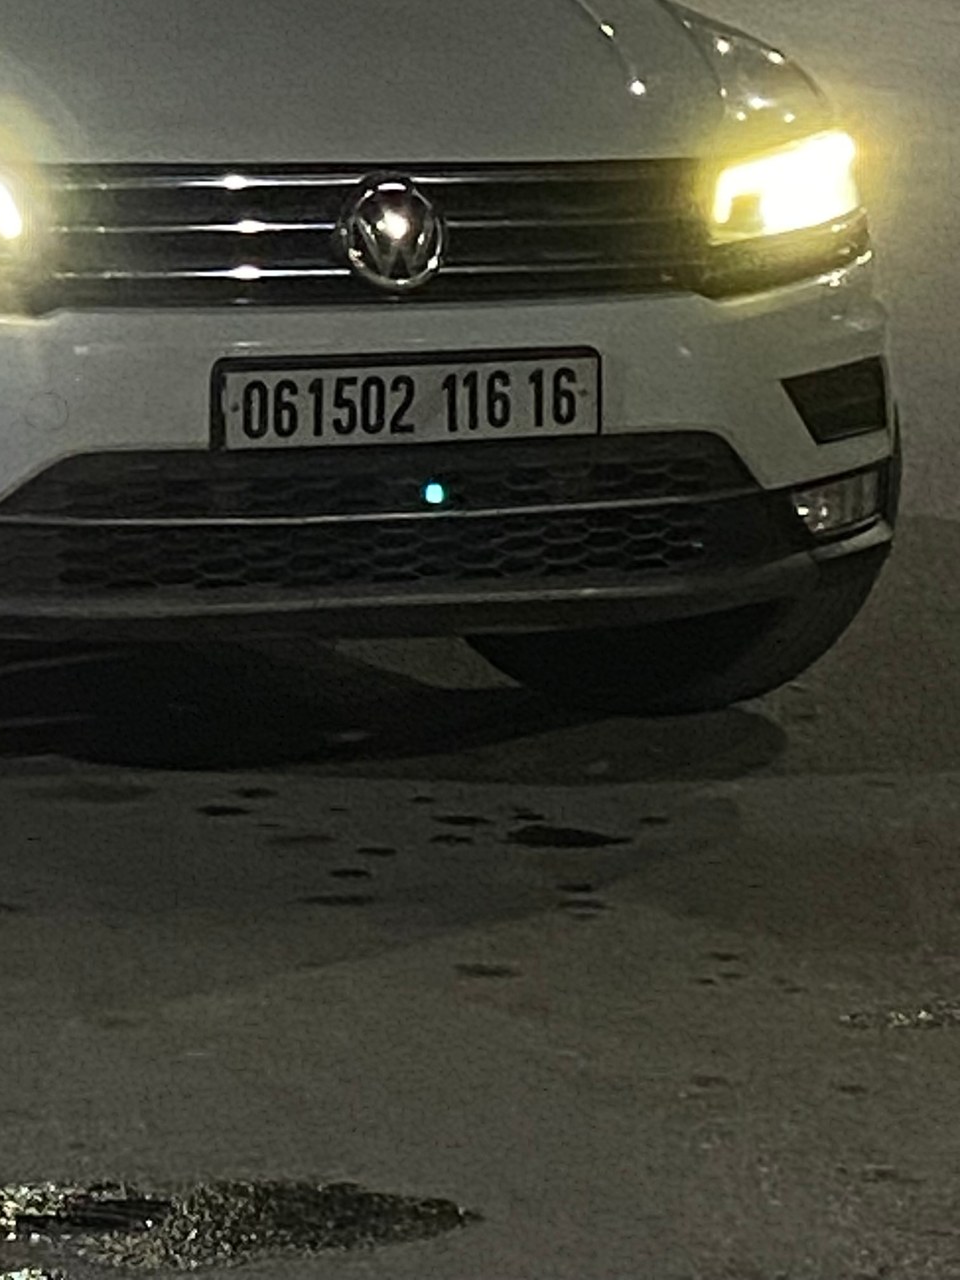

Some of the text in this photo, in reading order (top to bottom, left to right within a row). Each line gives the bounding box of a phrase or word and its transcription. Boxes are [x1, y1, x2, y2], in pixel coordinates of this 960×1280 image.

[243, 367, 577, 439] 061502 116 16
